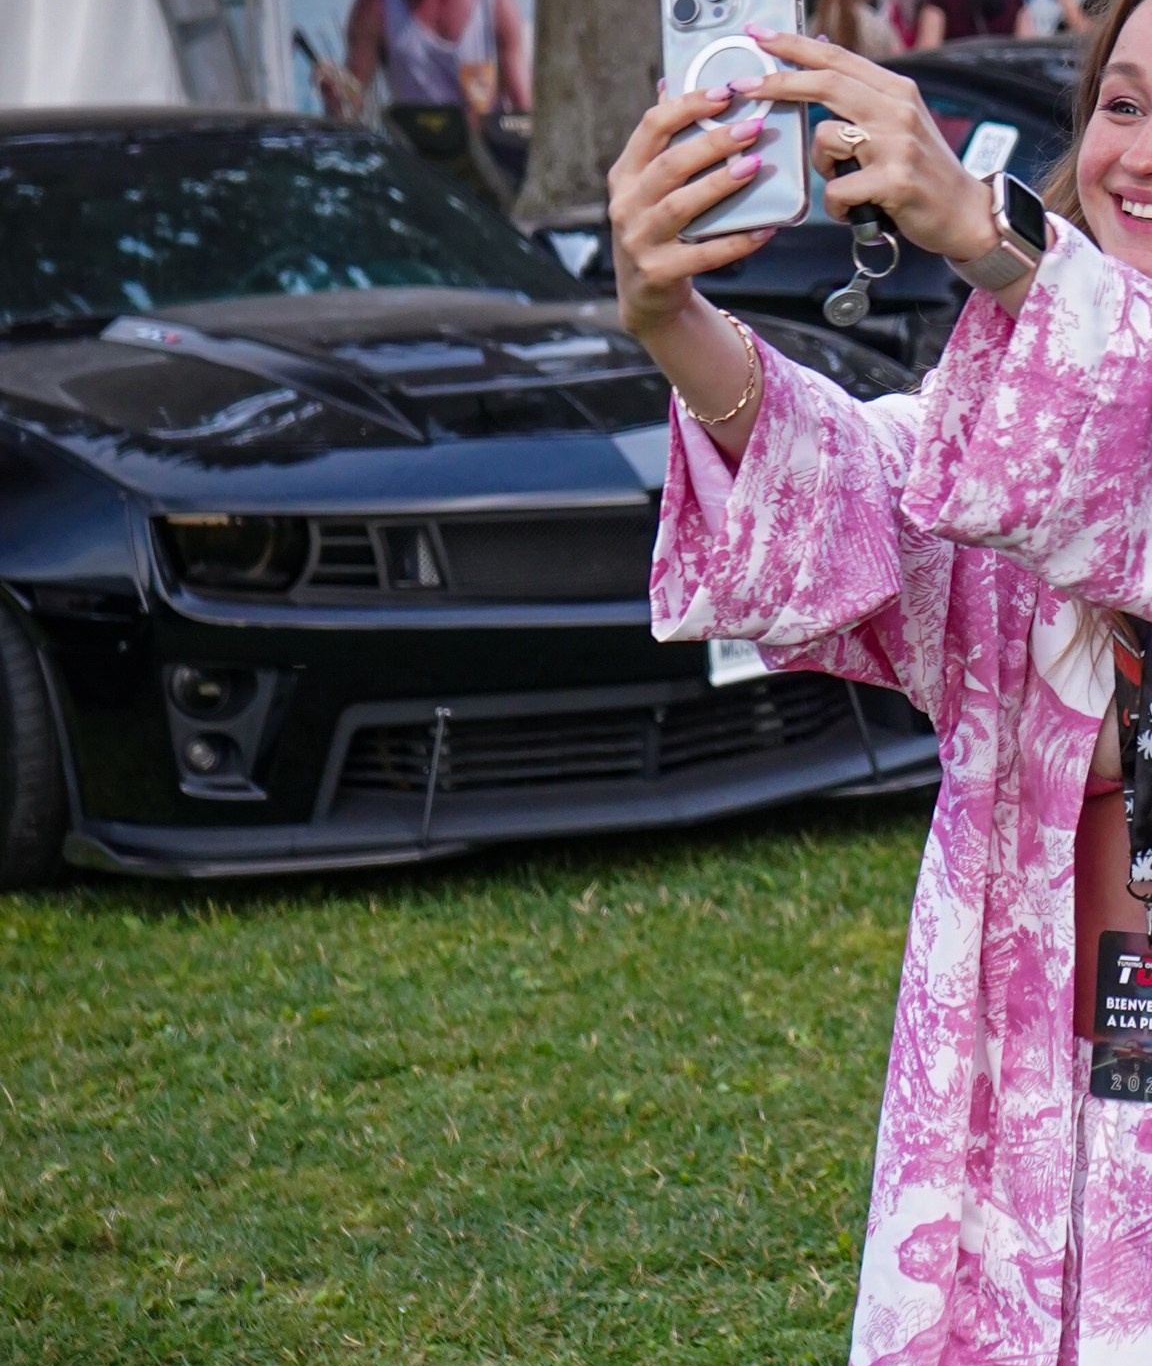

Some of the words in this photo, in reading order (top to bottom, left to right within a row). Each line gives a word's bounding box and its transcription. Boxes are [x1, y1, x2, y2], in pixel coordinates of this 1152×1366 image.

[1117, 960, 1143, 969] TUNING
[1106, 1014, 1117, 1027] A
[1119, 1015, 1137, 1029] LA
